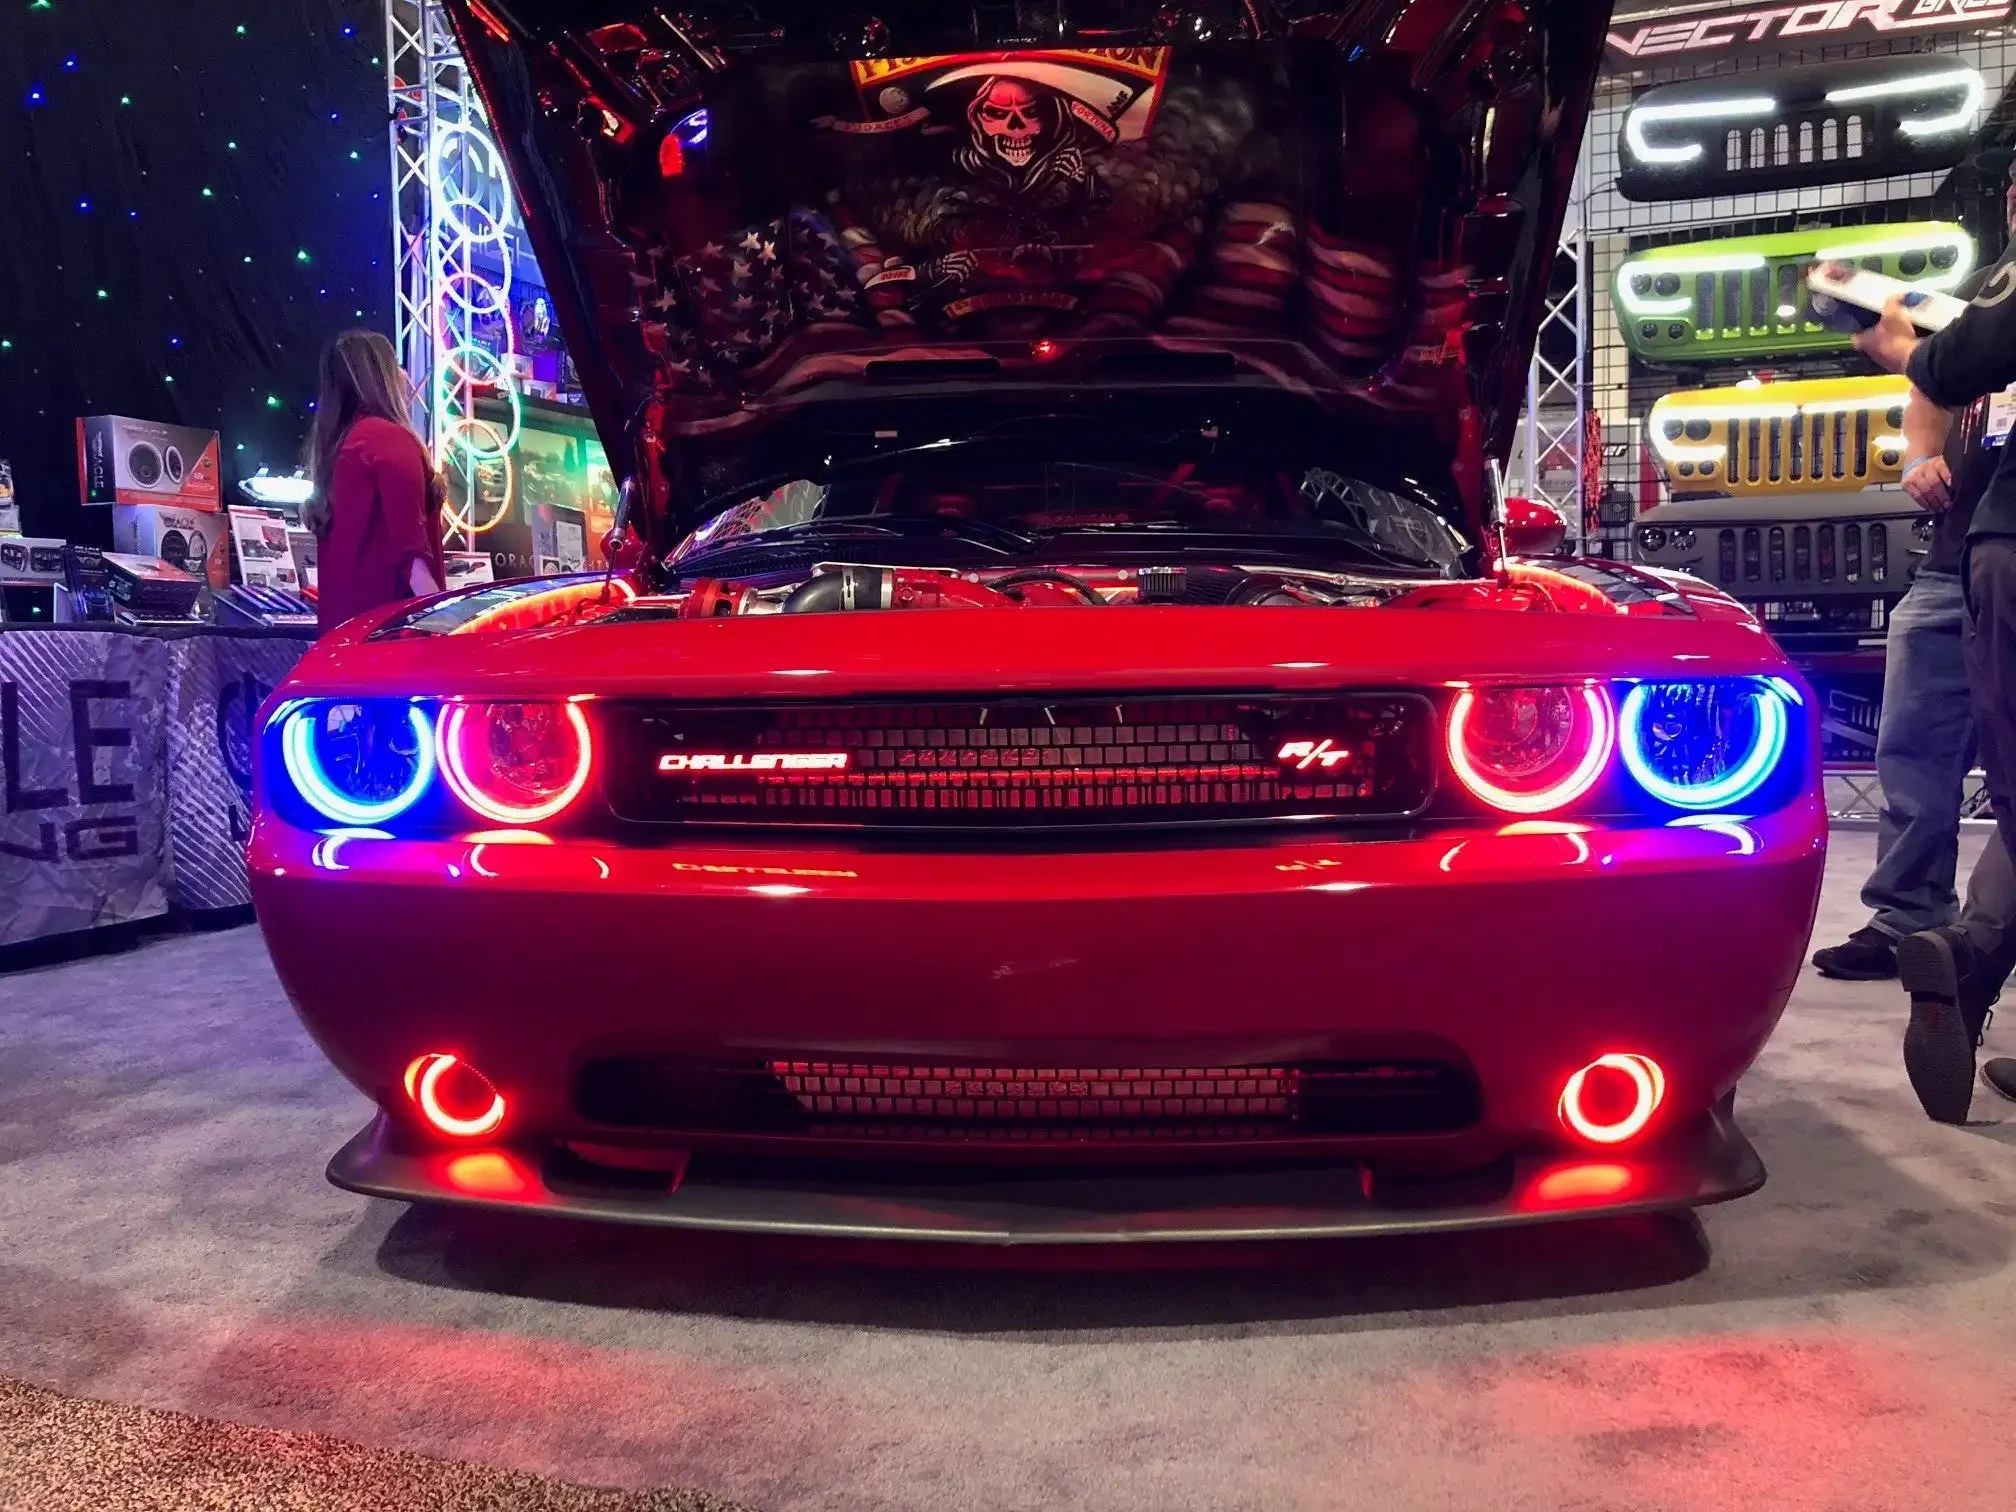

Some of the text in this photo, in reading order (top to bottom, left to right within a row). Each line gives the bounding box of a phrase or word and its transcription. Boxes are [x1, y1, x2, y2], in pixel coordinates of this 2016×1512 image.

[1605, 0, 1905, 56] VECTOR
[659, 739, 1349, 770] CHALLENGER R/T
